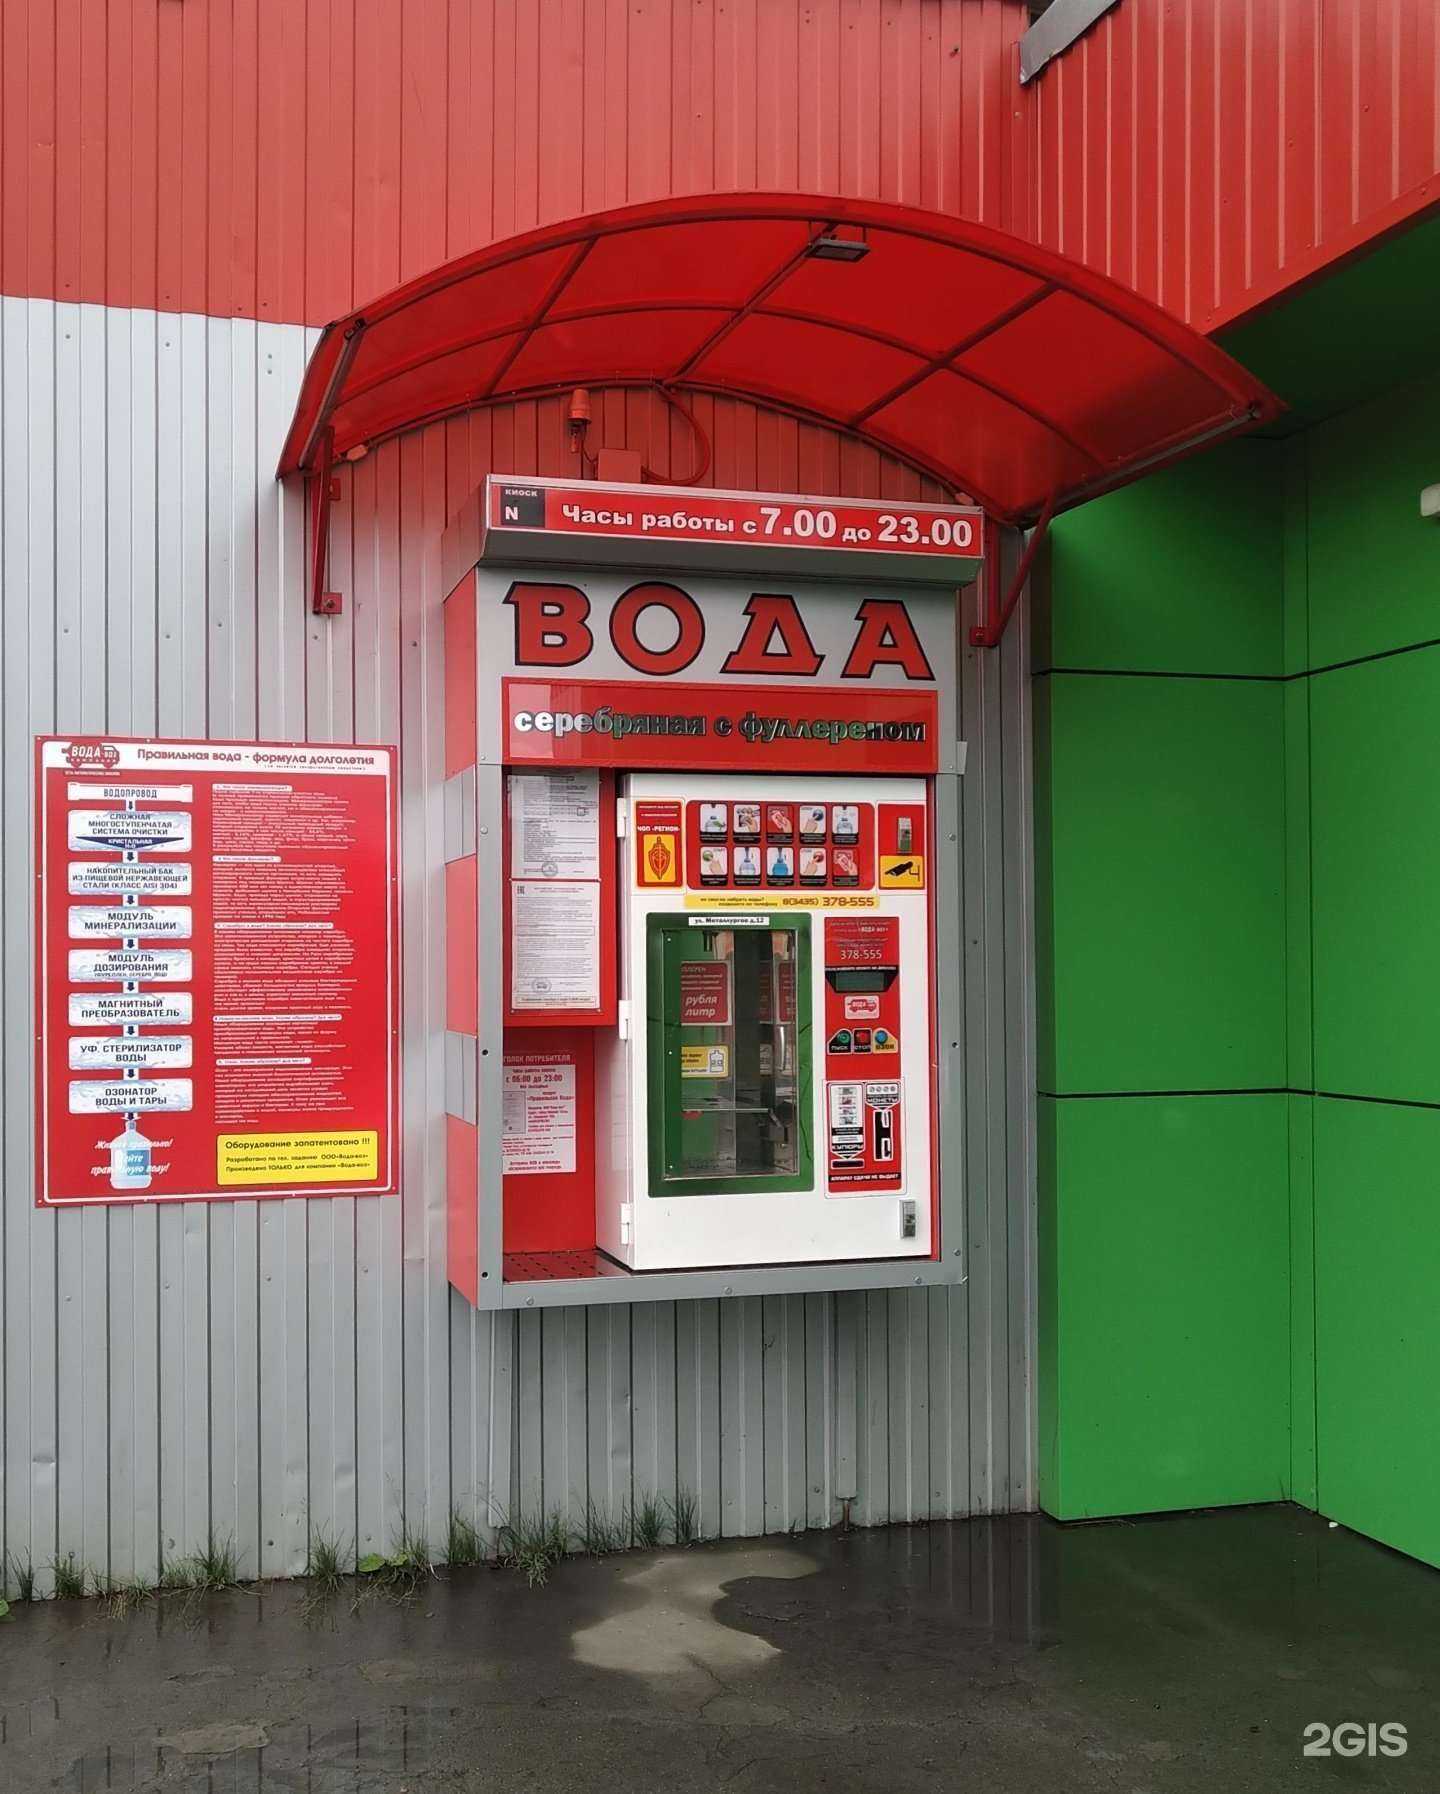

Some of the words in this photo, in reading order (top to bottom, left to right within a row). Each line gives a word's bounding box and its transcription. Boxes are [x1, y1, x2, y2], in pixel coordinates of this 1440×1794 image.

[505, 506, 519, 521] N
[562, 504, 633, 526] Часы
[642, 511, 734, 532] работы
[742, 519, 758, 534] с
[759, 507, 837, 539] 7.00
[842, 526, 872, 543] до
[877, 514, 973, 548] 23.00
[502, 580, 936, 682] ВОДА
[513, 705, 706, 740] серебряная
[714, 719, 732, 736] с
[738, 711, 927, 744] фуллереном
[72, 745, 101, 758] ВОДА
[137, 748, 209, 761] Правильная
[212, 751, 242, 762] вода
[252, 752, 307, 765] формула
[309, 755, 375, 766] долголетия
[103, 788, 158, 798] ВОДОПРОВОД
[109, 813, 151, 821] СЛОЖНАЯ
[88, 820, 172, 829] МНОГОСТУПЕНЧАТАЯ
[92, 828, 130, 836] СИСТЕМА
[131, 828, 168, 836] ОЧИСТКИ
[86, 866, 157, 875] НАКОПИТЕЛЬНЫЙ
[158, 867, 174, 875] БАК
[84, 874, 124, 883] ПИЩЕВОЙ
[125, 874, 188, 883] НЕРЖАВЕЮЩЕЙ
[111, 882, 141, 890] (КЛАСС
[822, 896, 875, 908] 378-555
[108, 912, 154, 921] МОДУЛЬ
[705, 917, 749, 925] Металлургов
[84, 921, 177, 931] МИНЕРАЛИЗАЦИИ
[108, 954, 154, 963] МОДУЛЬ
[840, 949, 882, 960] 378-555
[93, 963, 169, 972] ДОЗИРОВАНИЯ
[98, 999, 163, 1008] МАГНИТНЫЙ
[686, 993, 718, 1007] рубля
[81, 1009, 180, 1018] ПРЕОБРАЗОВАТЕЛЬ
[685, 1007, 716, 1018] литр
[103, 1043, 182, 1053] СТЕРИЛИЗАТОР
[115, 1053, 147, 1062] ВОДЫ
[105, 1087, 158, 1096] ОЗОНАТОР
[95, 1098, 127, 1106] ВОДЫ
[139, 1097, 167, 1105] ТАРЫ
[225, 1140, 292, 1151] Оборудование
[293, 1139, 360, 1148] запатентовано
[361, 1137, 371, 1145] !!!
[268, 1163, 294, 1171] ТОЛЬКО
